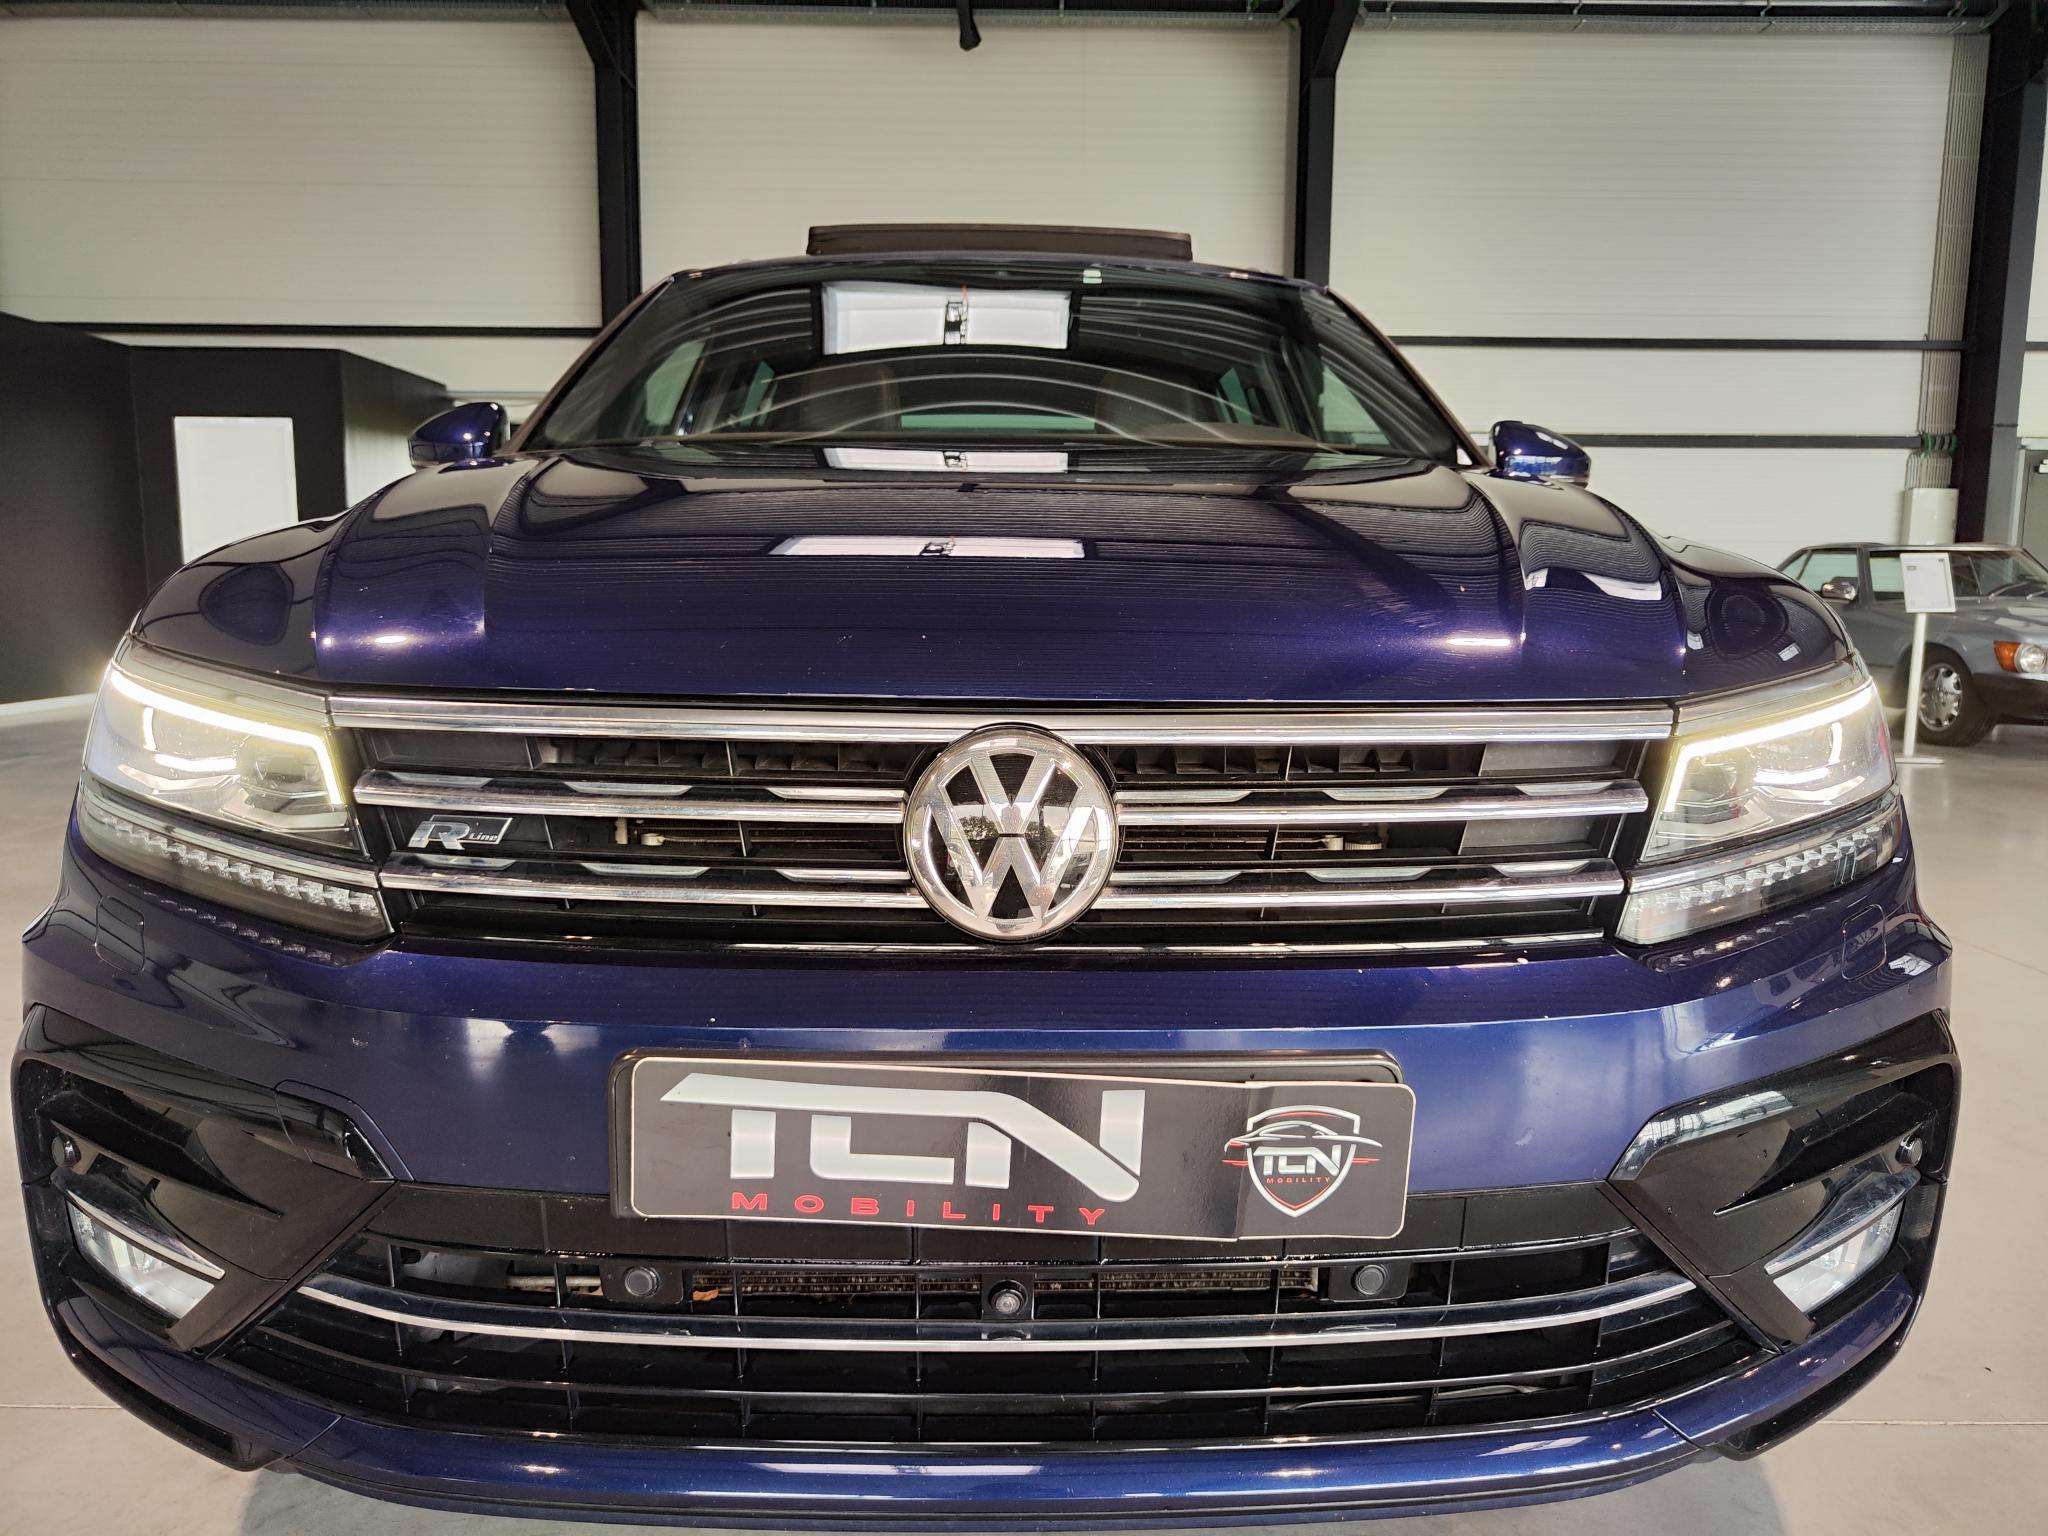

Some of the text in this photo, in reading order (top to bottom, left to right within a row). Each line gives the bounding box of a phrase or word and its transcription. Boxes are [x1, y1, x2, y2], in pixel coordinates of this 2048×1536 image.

[408, 821, 470, 850] R
[908, 726, 1116, 939] VW
[730, 1190, 1106, 1227] MOBILITY
